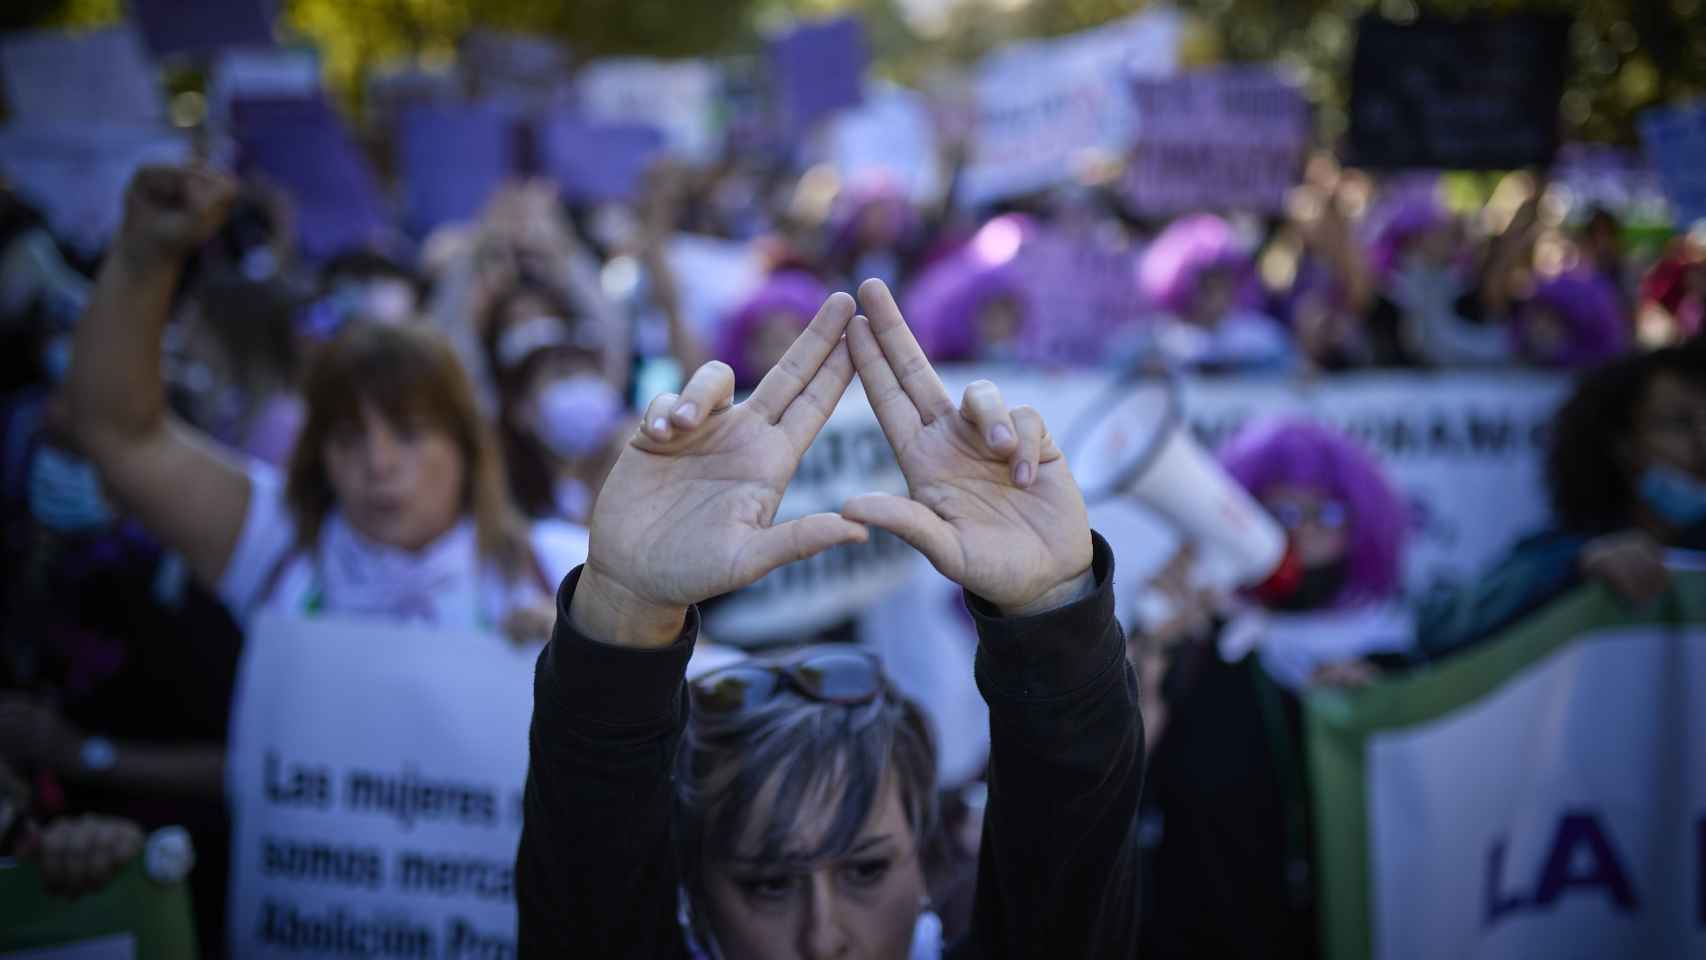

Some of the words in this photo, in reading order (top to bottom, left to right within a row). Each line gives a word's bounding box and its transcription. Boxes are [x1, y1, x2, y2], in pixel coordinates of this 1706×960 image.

[264, 750, 329, 809] Las
[347, 763, 498, 831] mujeres
[263, 838, 380, 891] somos
[1480, 804, 1641, 934] LA
[260, 900, 430, 960] Abolición
